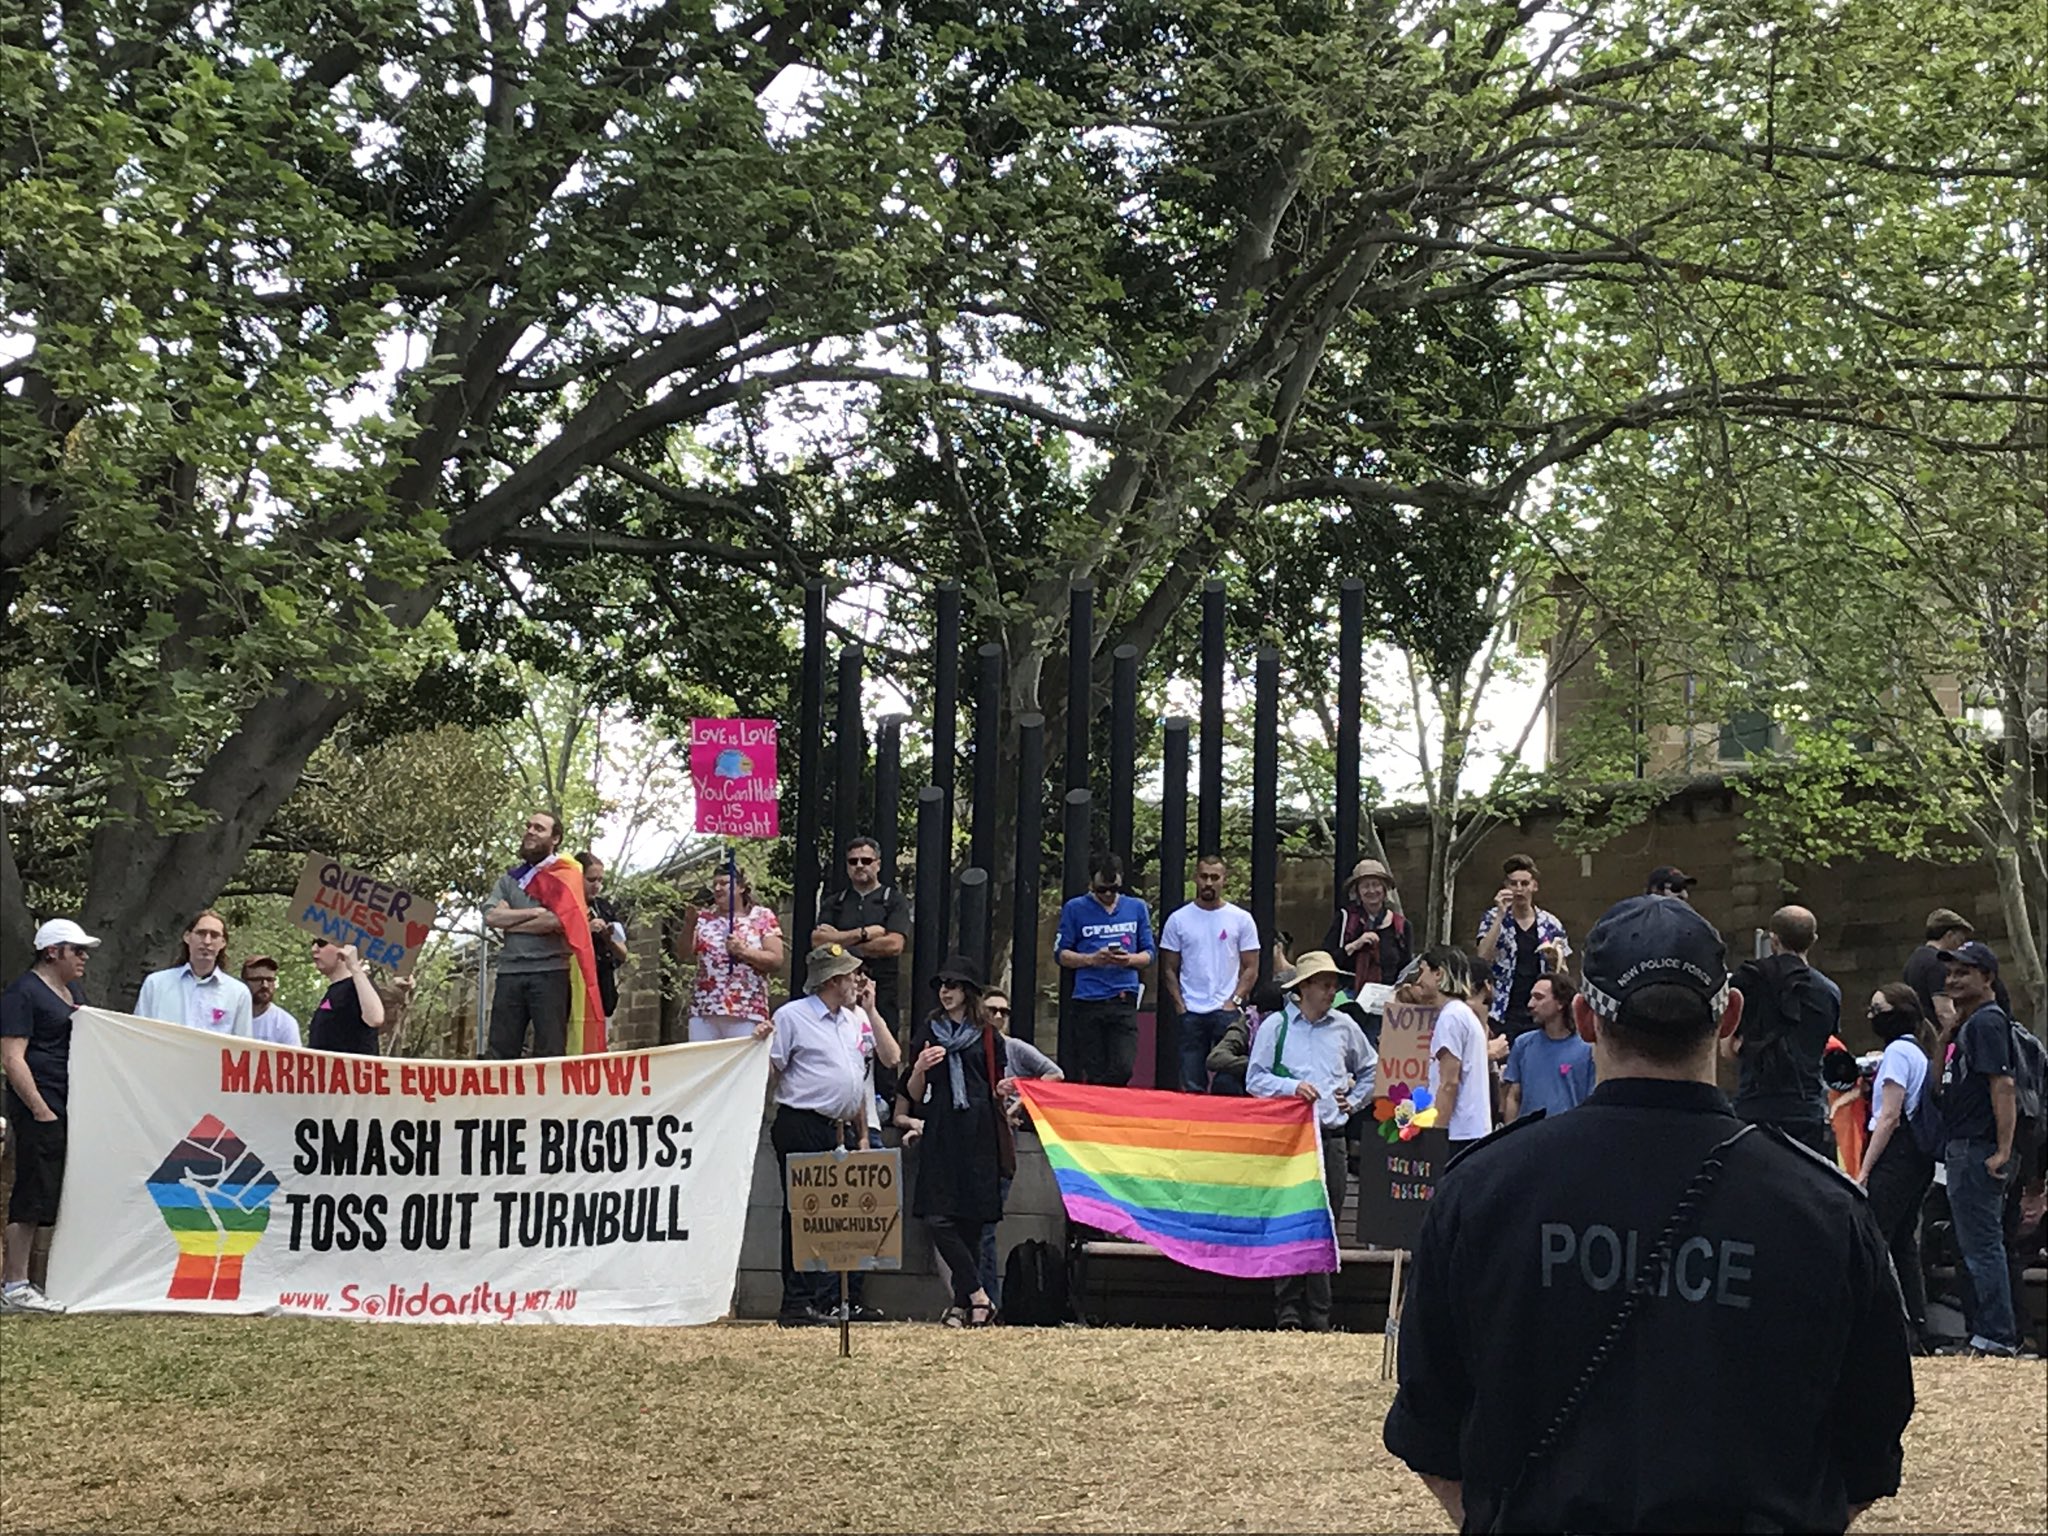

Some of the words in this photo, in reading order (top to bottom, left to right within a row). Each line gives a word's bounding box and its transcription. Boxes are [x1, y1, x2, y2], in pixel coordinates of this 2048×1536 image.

[314, 887, 388, 937] LIVES
[320, 863, 412, 922] QUEER
[303, 905, 405, 970] MATTER
[1617, 966, 1639, 988] NSW
[1640, 957, 1680, 973] POLICE
[1682, 961, 1713, 986] FORCE
[221, 1048, 391, 1096] MARRIAGE
[561, 1054, 652, 1096] NOW!
[293, 1118, 441, 1176] SMASH
[454, 1118, 527, 1176] THE
[540, 1114, 693, 1175] BIGOTS;
[791, 1165, 838, 1188] NAZIS
[845, 1164, 892, 1190] GTFO
[831, 1193, 850, 1208] OF
[286, 1193, 388, 1252] TOSS
[400, 1192, 480, 1251] OUT
[499, 1185, 689, 1249] TURNBULL
